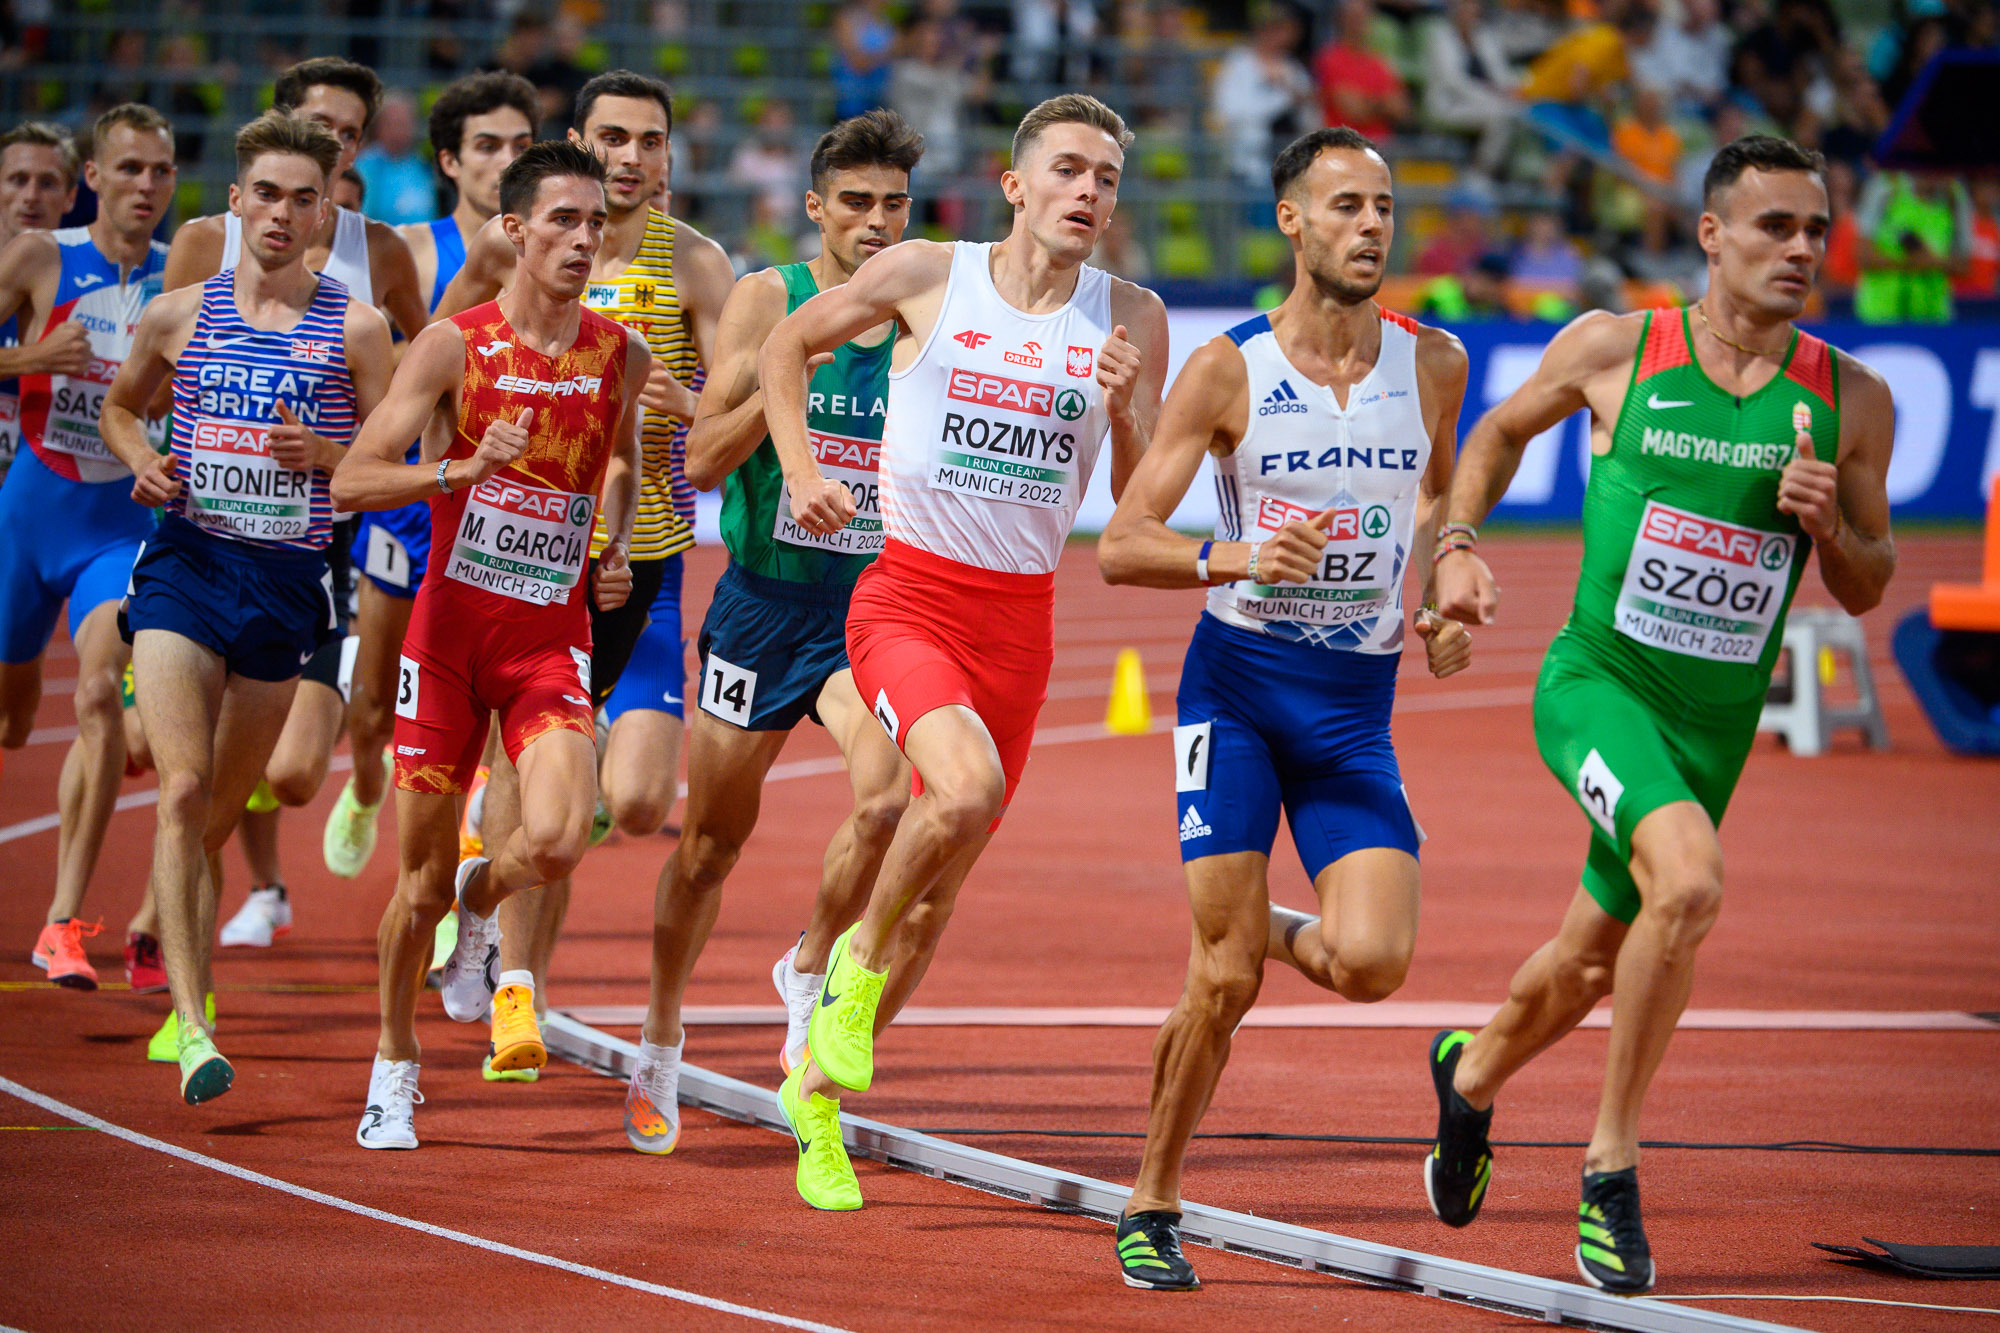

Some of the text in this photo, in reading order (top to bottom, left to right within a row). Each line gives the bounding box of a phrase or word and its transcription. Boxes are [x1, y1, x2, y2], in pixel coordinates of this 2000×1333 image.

[953, 330, 992, 350] 4F
[1005, 353, 1041, 368] ORLEN
[199, 364, 323, 398] GREAT
[494, 374, 602, 397] ESPAÑA
[952, 373, 1050, 412] SPAR
[1258, 402, 1308, 416] adidas
[941, 412, 1075, 464] ROZMYS
[965, 456, 970, 466] I
[973, 458, 999, 472] RUN
[1261, 447, 1418, 476] FRANCE
[193, 461, 308, 498] STONIER
[937, 467, 1063, 505] MUNICH 2022
[212, 500, 216, 509] I
[218, 500, 242, 512] RUN
[476, 479, 567, 519] SPAR
[192, 511, 302, 536] MUNICH 2022
[1261, 503, 1356, 537] SPR
[1647, 511, 1757, 562] SPAR
[461, 511, 582, 567] M. GARCÍA
[455, 560, 526, 595] MUNICH
[481, 555, 488, 565] I
[487, 558, 514, 572] RUN
[1274, 588, 1278, 596] I
[1281, 588, 1309, 598] RUN
[1639, 558, 1773, 615] SZÖGI
[1246, 600, 1376, 621] MUNICH 2022
[1662, 607, 1692, 623] RUN
[1624, 613, 1754, 657] MUNICH 2022
[713, 668, 747, 713] 14
[397, 744, 426, 757] ESP
[1584, 775, 1607, 816] 5
